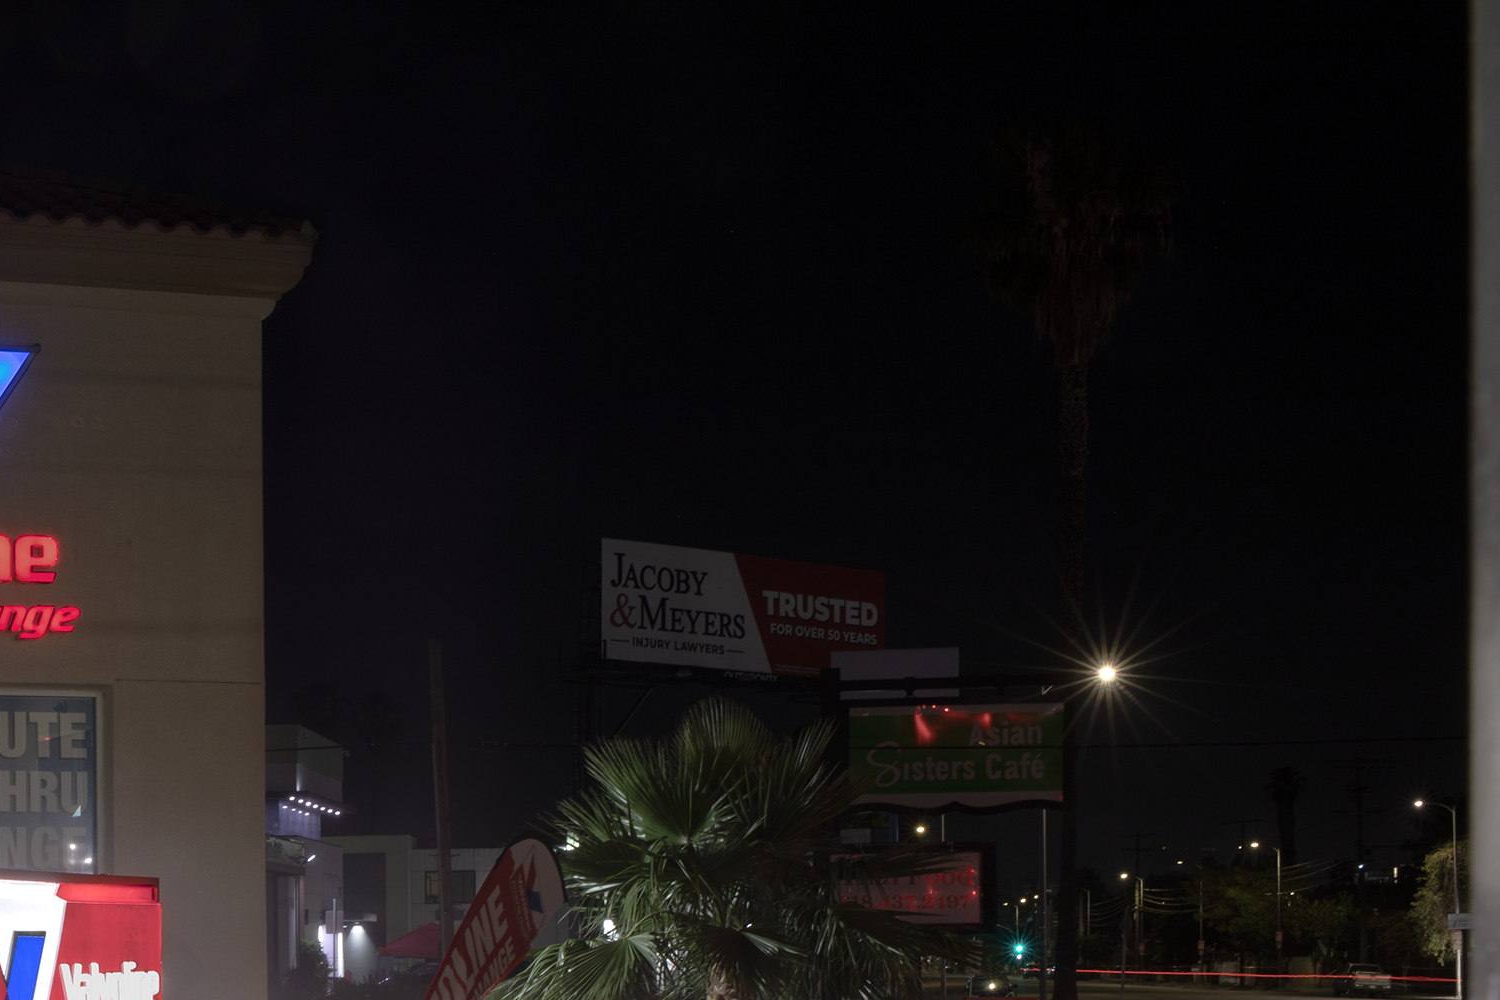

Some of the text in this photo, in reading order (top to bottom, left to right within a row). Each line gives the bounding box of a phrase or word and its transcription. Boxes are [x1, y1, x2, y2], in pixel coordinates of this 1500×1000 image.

[610, 553, 708, 596] JACOBY
[762, 589, 879, 628] TRUSTED
[631, 636, 725, 656] INJURY LAWYERS
[770, 622, 878, 646] FOR OVER 50 YEARS
[968, 720, 1043, 746] Asian
[866, 741, 1045, 787] Sisters Café
